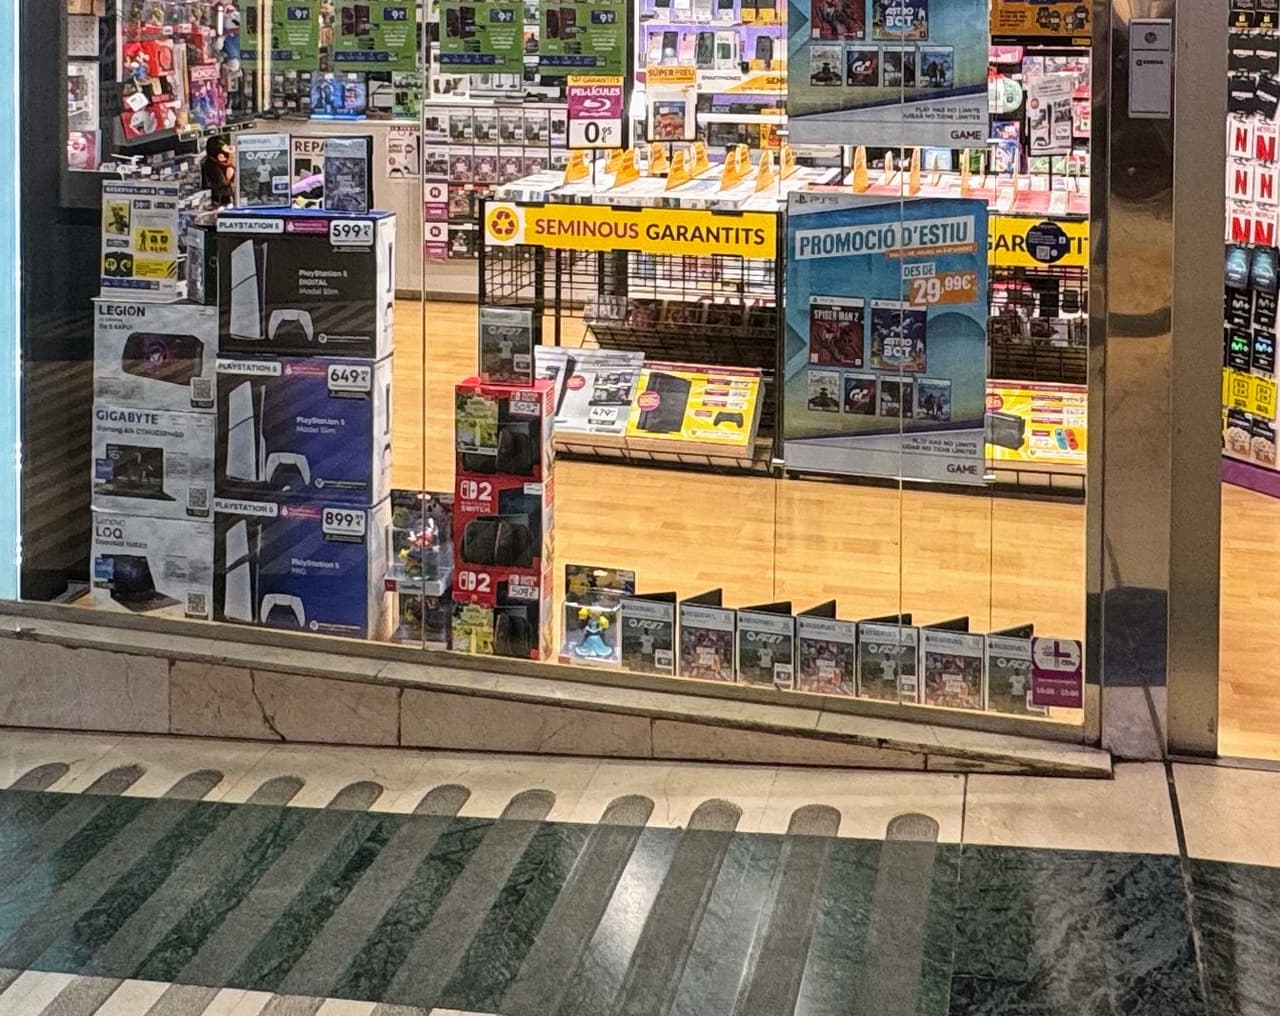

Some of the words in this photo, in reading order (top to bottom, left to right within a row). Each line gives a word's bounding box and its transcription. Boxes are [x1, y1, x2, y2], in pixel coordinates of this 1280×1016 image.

[950, 130, 982, 140] GAME
[218, 221, 274, 230] PLAYSTATION
[535, 218, 639, 239] SEMINOUS
[645, 223, 765, 246] GARANTITS
[799, 224, 896, 257] PROMOCIÓ
[901, 221, 968, 247] D'ESTIU
[903, 265, 921, 278] DES
[922, 263, 934, 275] DE
[99, 304, 146, 317] LEGION
[218, 362, 271, 373] PLAYSTATION
[95, 409, 159, 425] GIGABYTE
[946, 463, 978, 476] GAME
[215, 501, 268, 513] PLAYSTATION
[460, 504, 491, 513] SWITCH
[95, 527, 124, 540] LOQ
